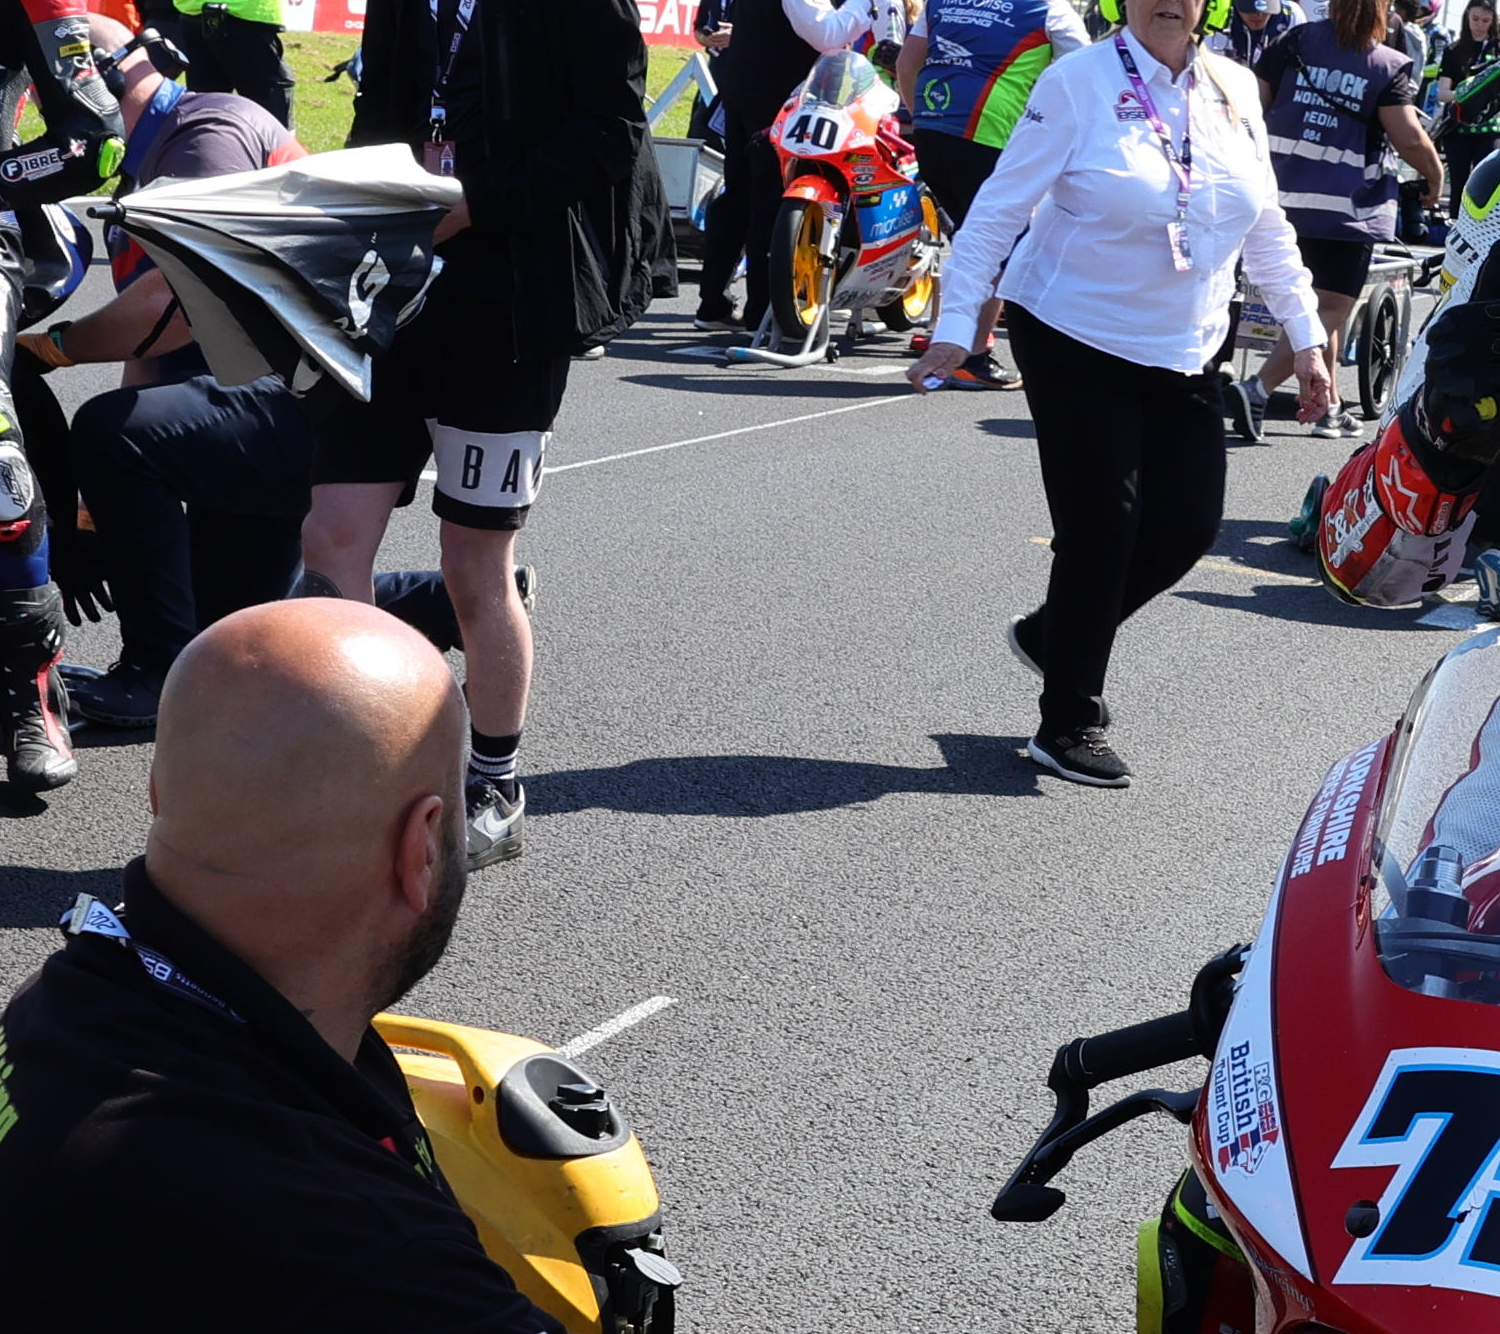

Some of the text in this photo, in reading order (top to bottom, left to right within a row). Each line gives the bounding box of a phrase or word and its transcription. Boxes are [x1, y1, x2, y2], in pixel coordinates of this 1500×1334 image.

[785, 114, 839, 151] 40
[1, 148, 61, 183] FIBRE
[1316, 737, 1382, 865] YORKSHIRE
[1213, 1058, 1231, 1145] Talent Cup
[1230, 1040, 1258, 1131] British
[1254, 1062, 1273, 1105] R&G
